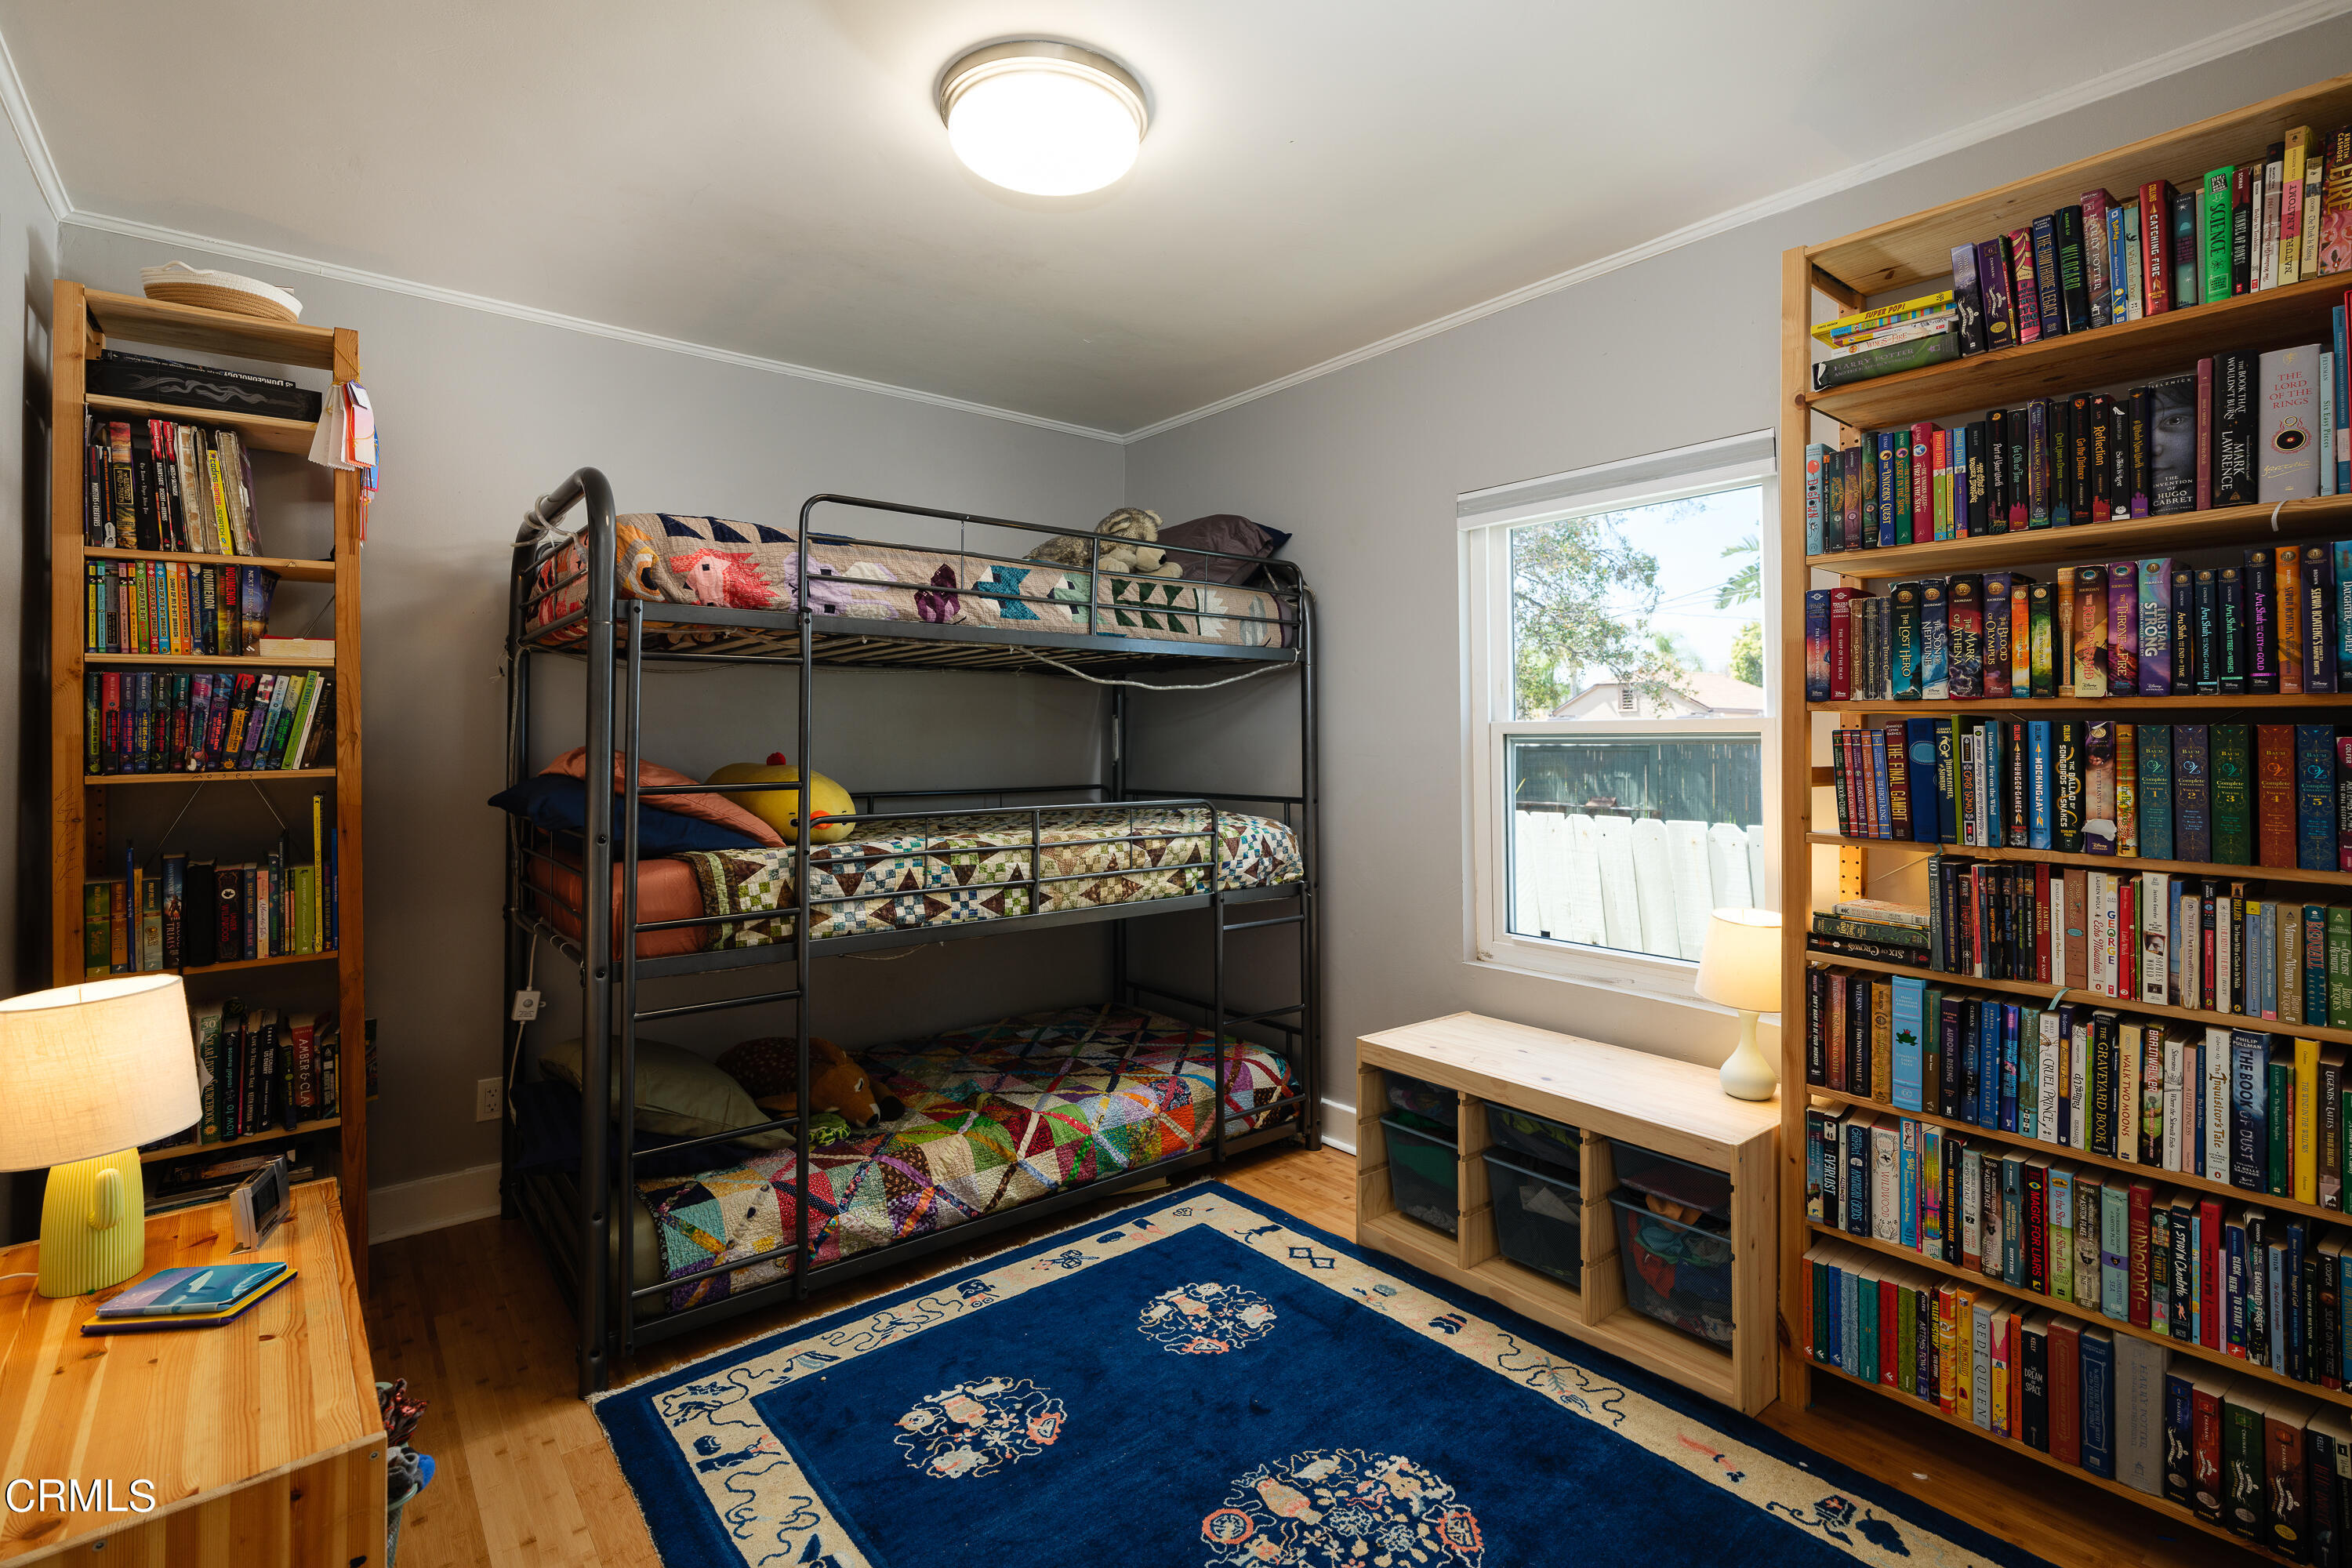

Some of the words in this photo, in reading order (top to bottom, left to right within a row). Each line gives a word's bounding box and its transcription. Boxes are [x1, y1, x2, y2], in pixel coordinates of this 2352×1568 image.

[2089, 213, 2100, 252] HARRY
[2151, 214, 2159, 256] CATCHING
[2210, 203, 2227, 257] SCIENCE
[2062, 244, 2081, 290] WILDCARD
[2234, 245, 2245, 266] BONES
[2285, 234, 2295, 274] NATURE
[2092, 252, 2102, 291] POTTER
[2151, 258, 2160, 278] FIRE
[1864, 309, 1886, 319] SUPER
[1888, 303, 1906, 314] POP!
[2238, 369, 2247, 392] BOOK
[2274, 379, 2307, 391] LORD
[2277, 371, 2302, 381] THE
[2269, 390, 2284, 401] OF
[2286, 387, 2313, 397] THE
[2273, 397, 2308, 409] RINGS
[2093, 424, 2106, 466] Reflection
[209, 459, 218, 483] coding
[2221, 430, 2233, 491] LAWRENCE
[2233, 443, 2245, 477] MARK
[212, 484, 221, 505] GAMES
[1882, 469, 1892, 502] UNICORN
[2153, 479, 2193, 488] INVENTION
[2158, 490, 2187, 499] HUGO
[1882, 503, 1891, 524] QUEST
[2153, 495, 2193, 506] CABRET
[215, 509, 224, 535] SCRATCH
[202, 568, 215, 610] NOUMENON
[225, 566, 237, 606] NOUMENON
[1900, 612, 1909, 625] THE
[1953, 614, 1960, 624] OF
[2082, 605, 2096, 630] RED
[2117, 603, 2129, 643] THRONE
[2201, 620, 2212, 637] Shah
[2226, 617, 2237, 633] Shah
[2256, 606, 2267, 625] Shah
[1898, 626, 1911, 648] LOST
[1985, 620, 1996, 665] OLYMPUS
[2144, 602, 2158, 657] STRONG
[2157, 607, 2168, 652] TRISTAN
[2177, 622, 2187, 640] Shah
[1922, 621, 1933, 666] NEPTUNE
[1933, 632, 1946, 656] SON
[1951, 625, 1962, 666] ATHENA
[1965, 630, 1978, 663] MARK
[1997, 626, 2009, 661] BLOOD
[2083, 631, 2096, 680] PYRAMID
[1899, 650, 1911, 677] HERO
[2117, 652, 2129, 676] FIRE
[2256, 652, 2265, 671] GOLD
[1888, 743, 1904, 759] THE
[1889, 763, 1905, 787] FINAL
[2034, 757, 2043, 813] MOCKINGJAY
[1890, 790, 1907, 822] GAMBIT
[1848, 942, 1879, 956] CROWS
[2107, 910, 2116, 965] GEORGE
[2307, 920, 2325, 969] REDWALL
[1888, 949, 1904, 959] SIX
[2092, 939, 2103, 975] Mountain
[299, 1039, 310, 1070] AMBER
[2122, 1055, 2131, 1079] WALK
[2148, 1029, 2158, 1093] BRAINWALKER
[2240, 1051, 2253, 1067] THE
[2043, 1058, 2055, 1087] CRUEL
[2096, 1043, 2108, 1110] GRAVEYARD
[299, 1082, 310, 1108] CLAY
[2122, 1081, 2131, 1098] TWO
[2240, 1069, 2253, 1109] BOOK
[2326, 1071, 2335, 1102] LEGENDS
[2209, 1073, 2227, 1127] Inquisitor's
[2096, 1113, 2107, 1143] BOOK
[2122, 1101, 2131, 1137] MOONS
[2214, 1130, 2225, 1148] Tale
[2240, 1130, 2254, 1161] DUST
[1824, 1153, 1836, 1196] EVERLOST
[1851, 1168, 1862, 1200] AMERICAN
[1881, 1171, 1889, 1218] WILDWOOD
[2031, 1191, 2041, 1220] MAGIC
[1851, 1201, 1862, 1221] GODS
[2031, 1223, 2041, 1243] FOR
[2175, 1231, 2186, 1253] STUDY
[2031, 1248, 2042, 1277] LIARS
[2233, 1256, 2241, 1276] CLICK
[2229, 1276, 2238, 1293] HERE
[2234, 1296, 2242, 1305] TO
[2233, 1308, 2242, 1328] START
[1918, 1320, 1926, 1352] ARTEMIS
[1976, 1321, 1987, 1348] RED
[1918, 1354, 1926, 1371] FOWL
[2024, 1370, 2043, 1383] DREAM
[2025, 1382, 2042, 1396] SPACE
[1973, 1365, 1987, 1417] QUEEN
